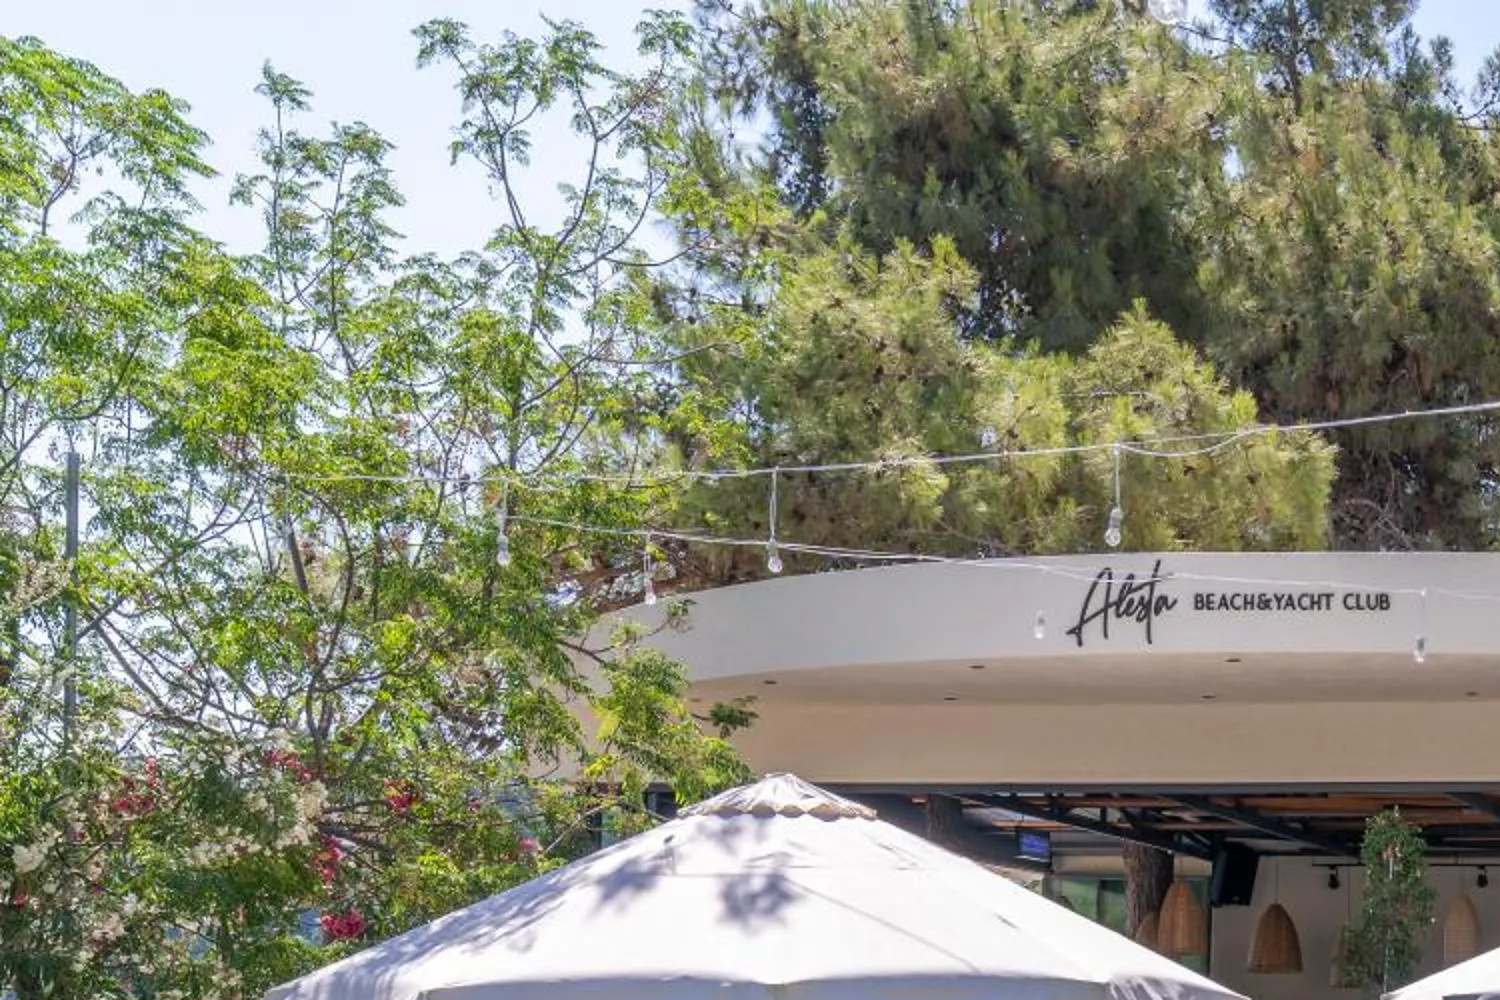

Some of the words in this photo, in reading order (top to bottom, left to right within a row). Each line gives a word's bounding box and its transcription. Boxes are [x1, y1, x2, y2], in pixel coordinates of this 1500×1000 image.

[1066, 559, 1178, 647] Alesta
[1193, 592, 1334, 611] BEACH&YACHT
[1342, 592, 1391, 611] CLUB
